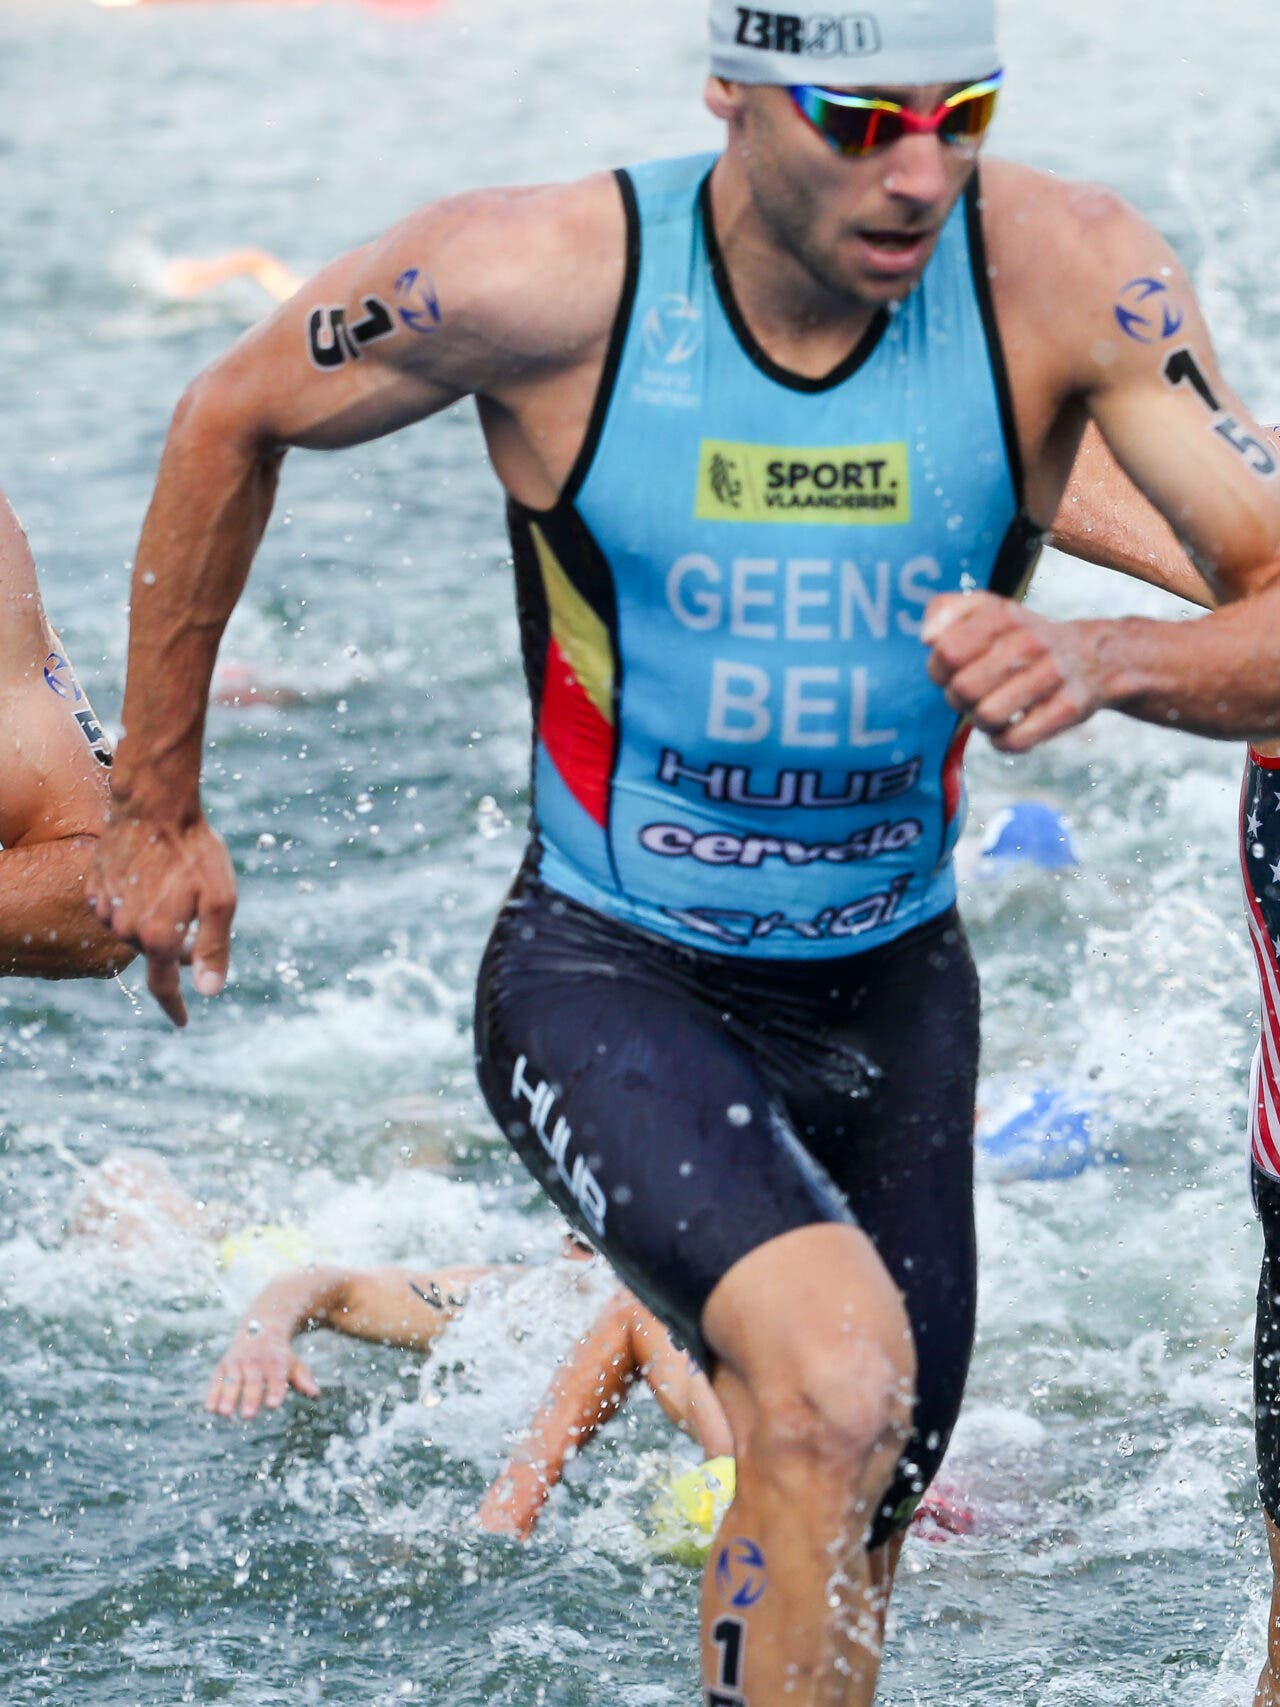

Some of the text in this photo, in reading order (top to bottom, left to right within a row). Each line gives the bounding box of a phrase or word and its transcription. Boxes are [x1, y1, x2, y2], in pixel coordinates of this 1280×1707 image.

[308, 297, 394, 368] 15
[1163, 349, 1275, 475] 15
[766, 460, 898, 489] SPORT.
[665, 551, 942, 641] GEENS
[705, 658, 897, 748] BEL
[656, 747, 922, 808] HUUB
[511, 1053, 607, 1237] HUUB
